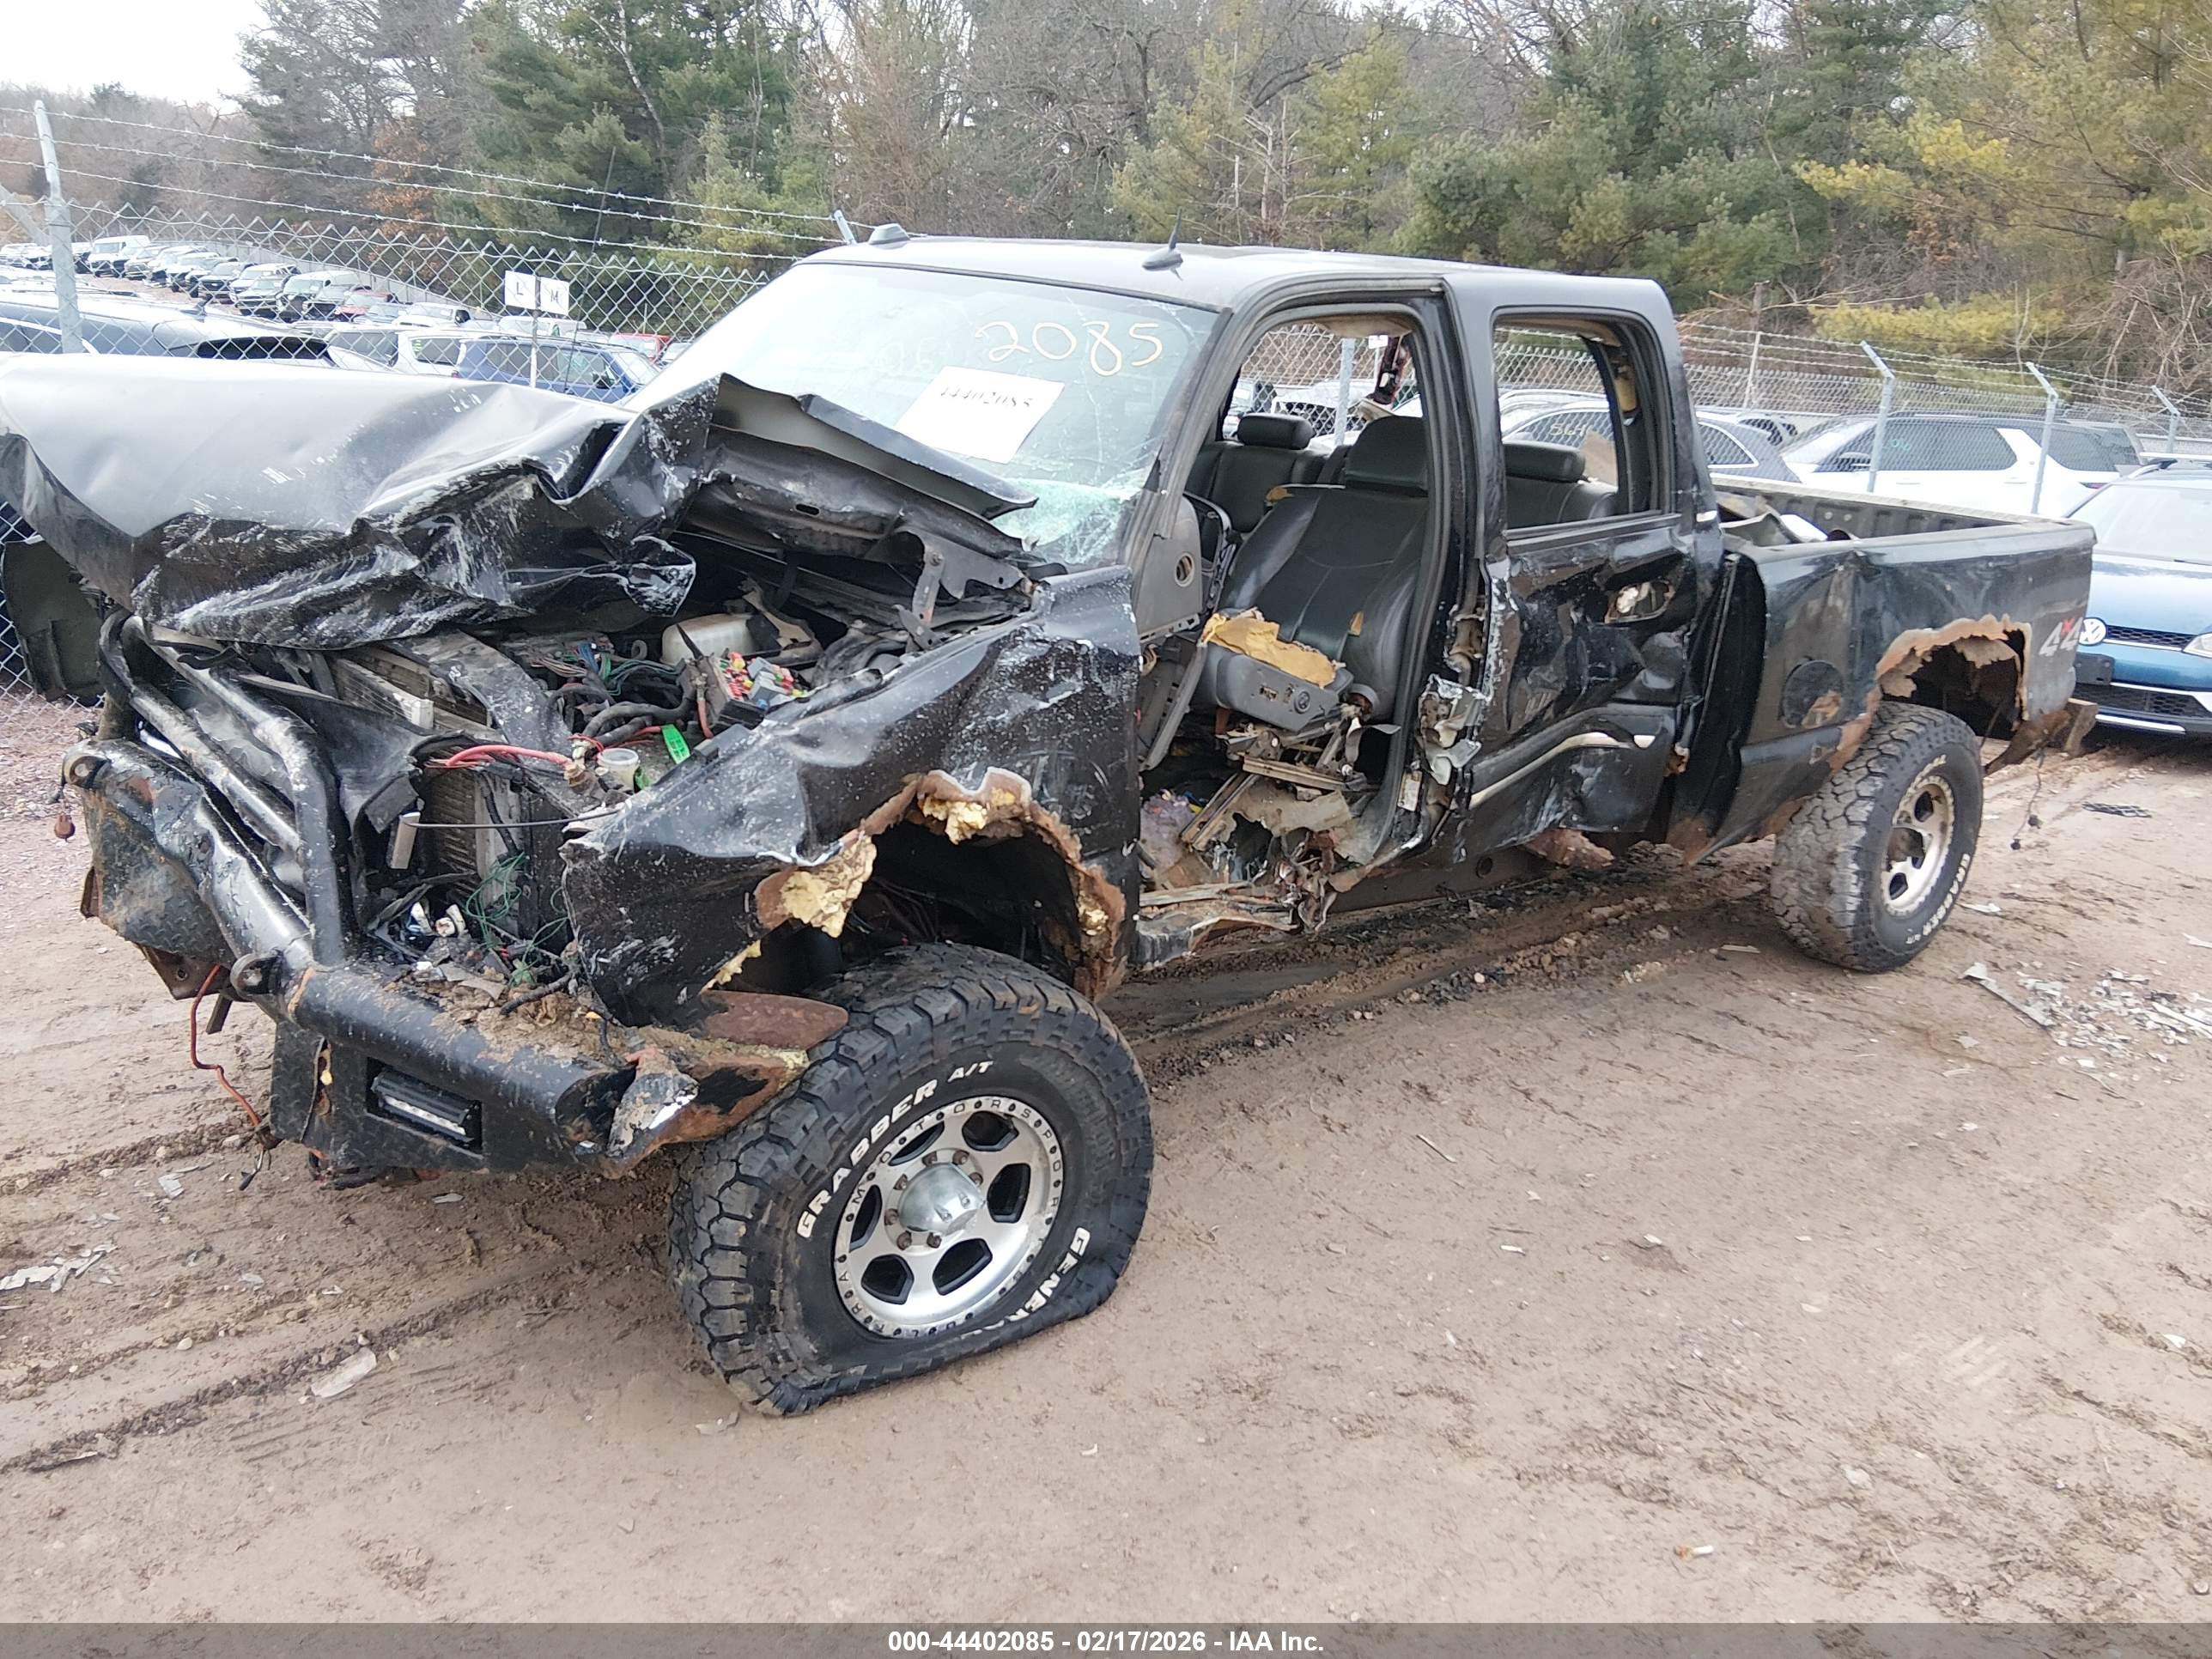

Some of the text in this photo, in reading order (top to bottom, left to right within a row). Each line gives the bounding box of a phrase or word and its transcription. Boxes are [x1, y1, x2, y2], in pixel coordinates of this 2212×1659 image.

[975, 321, 1163, 376] 2085
[796, 1060, 994, 1238] GRABBER A/T
